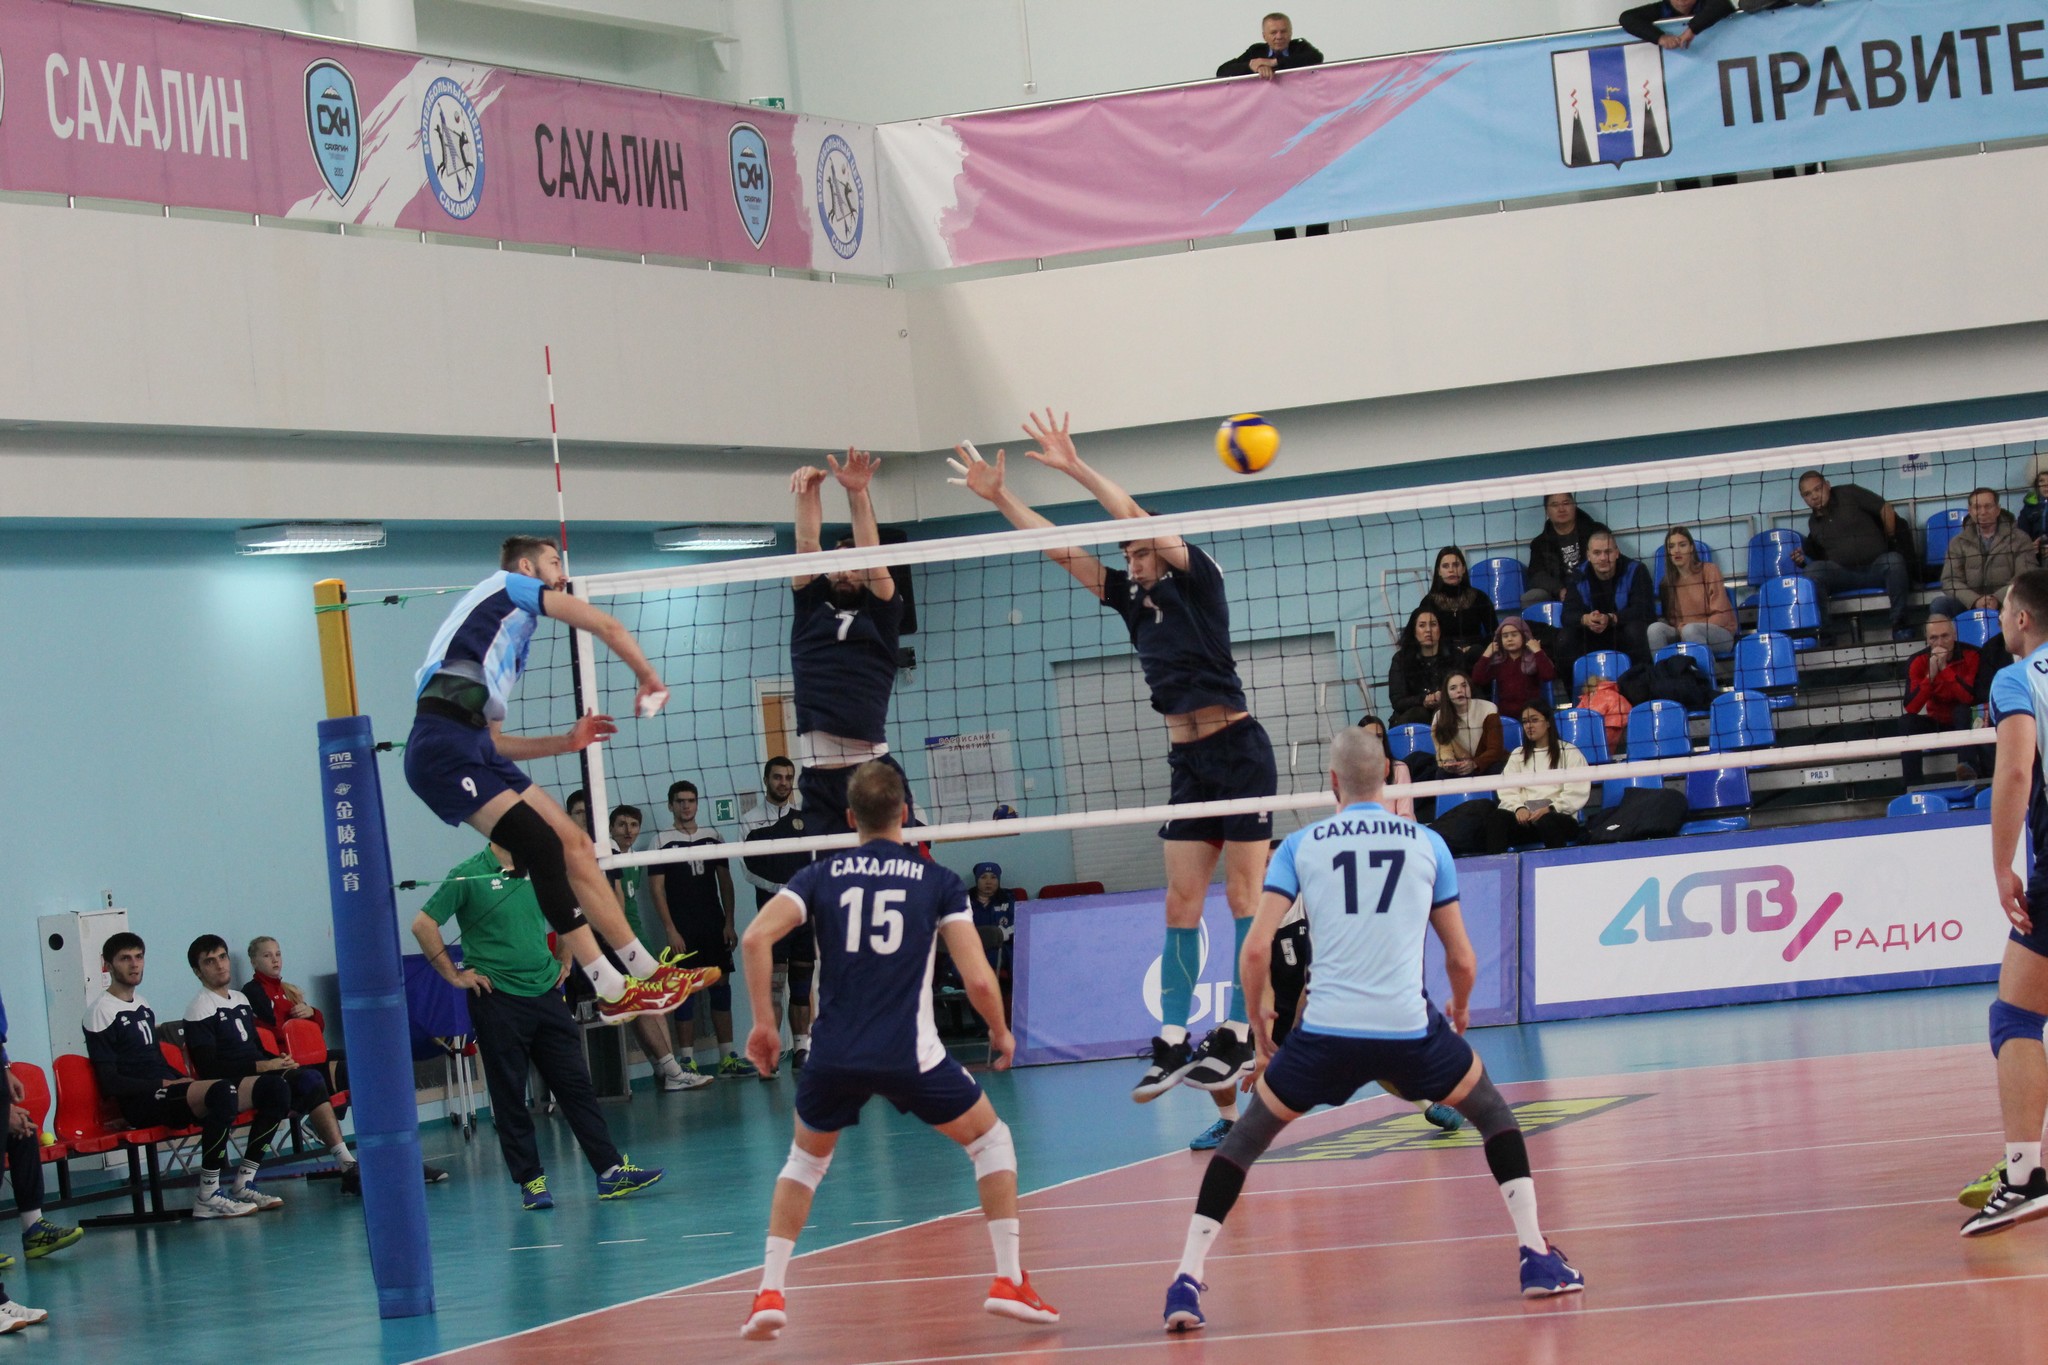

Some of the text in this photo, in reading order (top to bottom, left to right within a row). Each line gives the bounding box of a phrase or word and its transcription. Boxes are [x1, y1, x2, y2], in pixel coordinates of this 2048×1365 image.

[1717, 19, 2048, 127] ПРАВИТЕ
[45, 52, 248, 160] САХАЛИН
[421, 80, 484, 163] ВОЛЕЙБОЛЬНЫЙ ЦЕНТР
[534, 123, 688, 211] САХАЛИН
[439, 190, 477, 218] САХАЛИН
[831, 234, 858, 257] САХАЛИН
[836, 613, 855, 641] 7
[2033, 658, 2048, 674] С
[461, 776, 478, 798] 9
[1810, 770, 1824, 779] РЯД
[1312, 819, 1417, 841] САХАЛИН
[335, 800, 360, 892] 金陵体育
[830, 855, 925, 881] САХАЛИН
[1332, 849, 1406, 915] 17
[839, 886, 907, 955] 15
[1834, 919, 1963, 953] РАДИО
